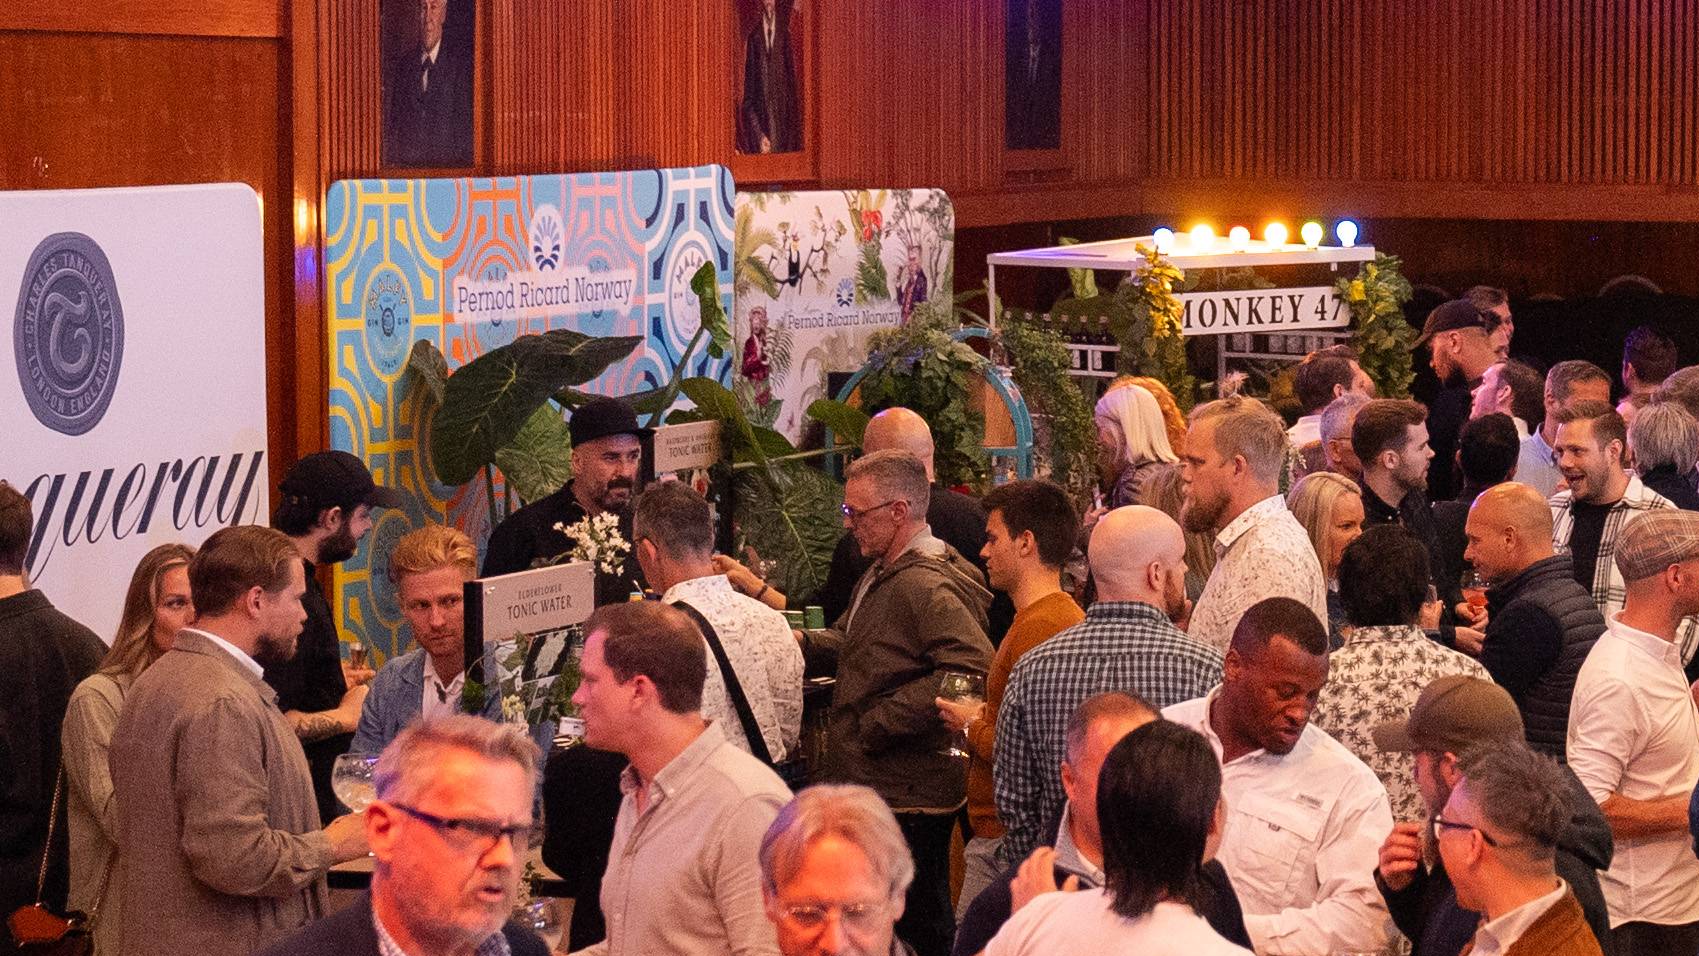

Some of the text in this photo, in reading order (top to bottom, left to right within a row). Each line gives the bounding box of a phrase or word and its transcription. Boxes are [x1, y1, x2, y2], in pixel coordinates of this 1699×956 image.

[24, 252, 114, 335] CHARLES TANQUERAY
[458, 276, 632, 313] Pernod Ricard Norway
[1314, 293, 1343, 322] 47
[787, 310, 900, 330] Pernod Ricard Norway
[27, 350, 111, 414] LONDON ENGLAND
[669, 445, 690, 458] TONIC
[23, 450, 264, 584] queray
[518, 584, 562, 599] ELDERFLOWER
[507, 594, 573, 620] TONIC WATER
